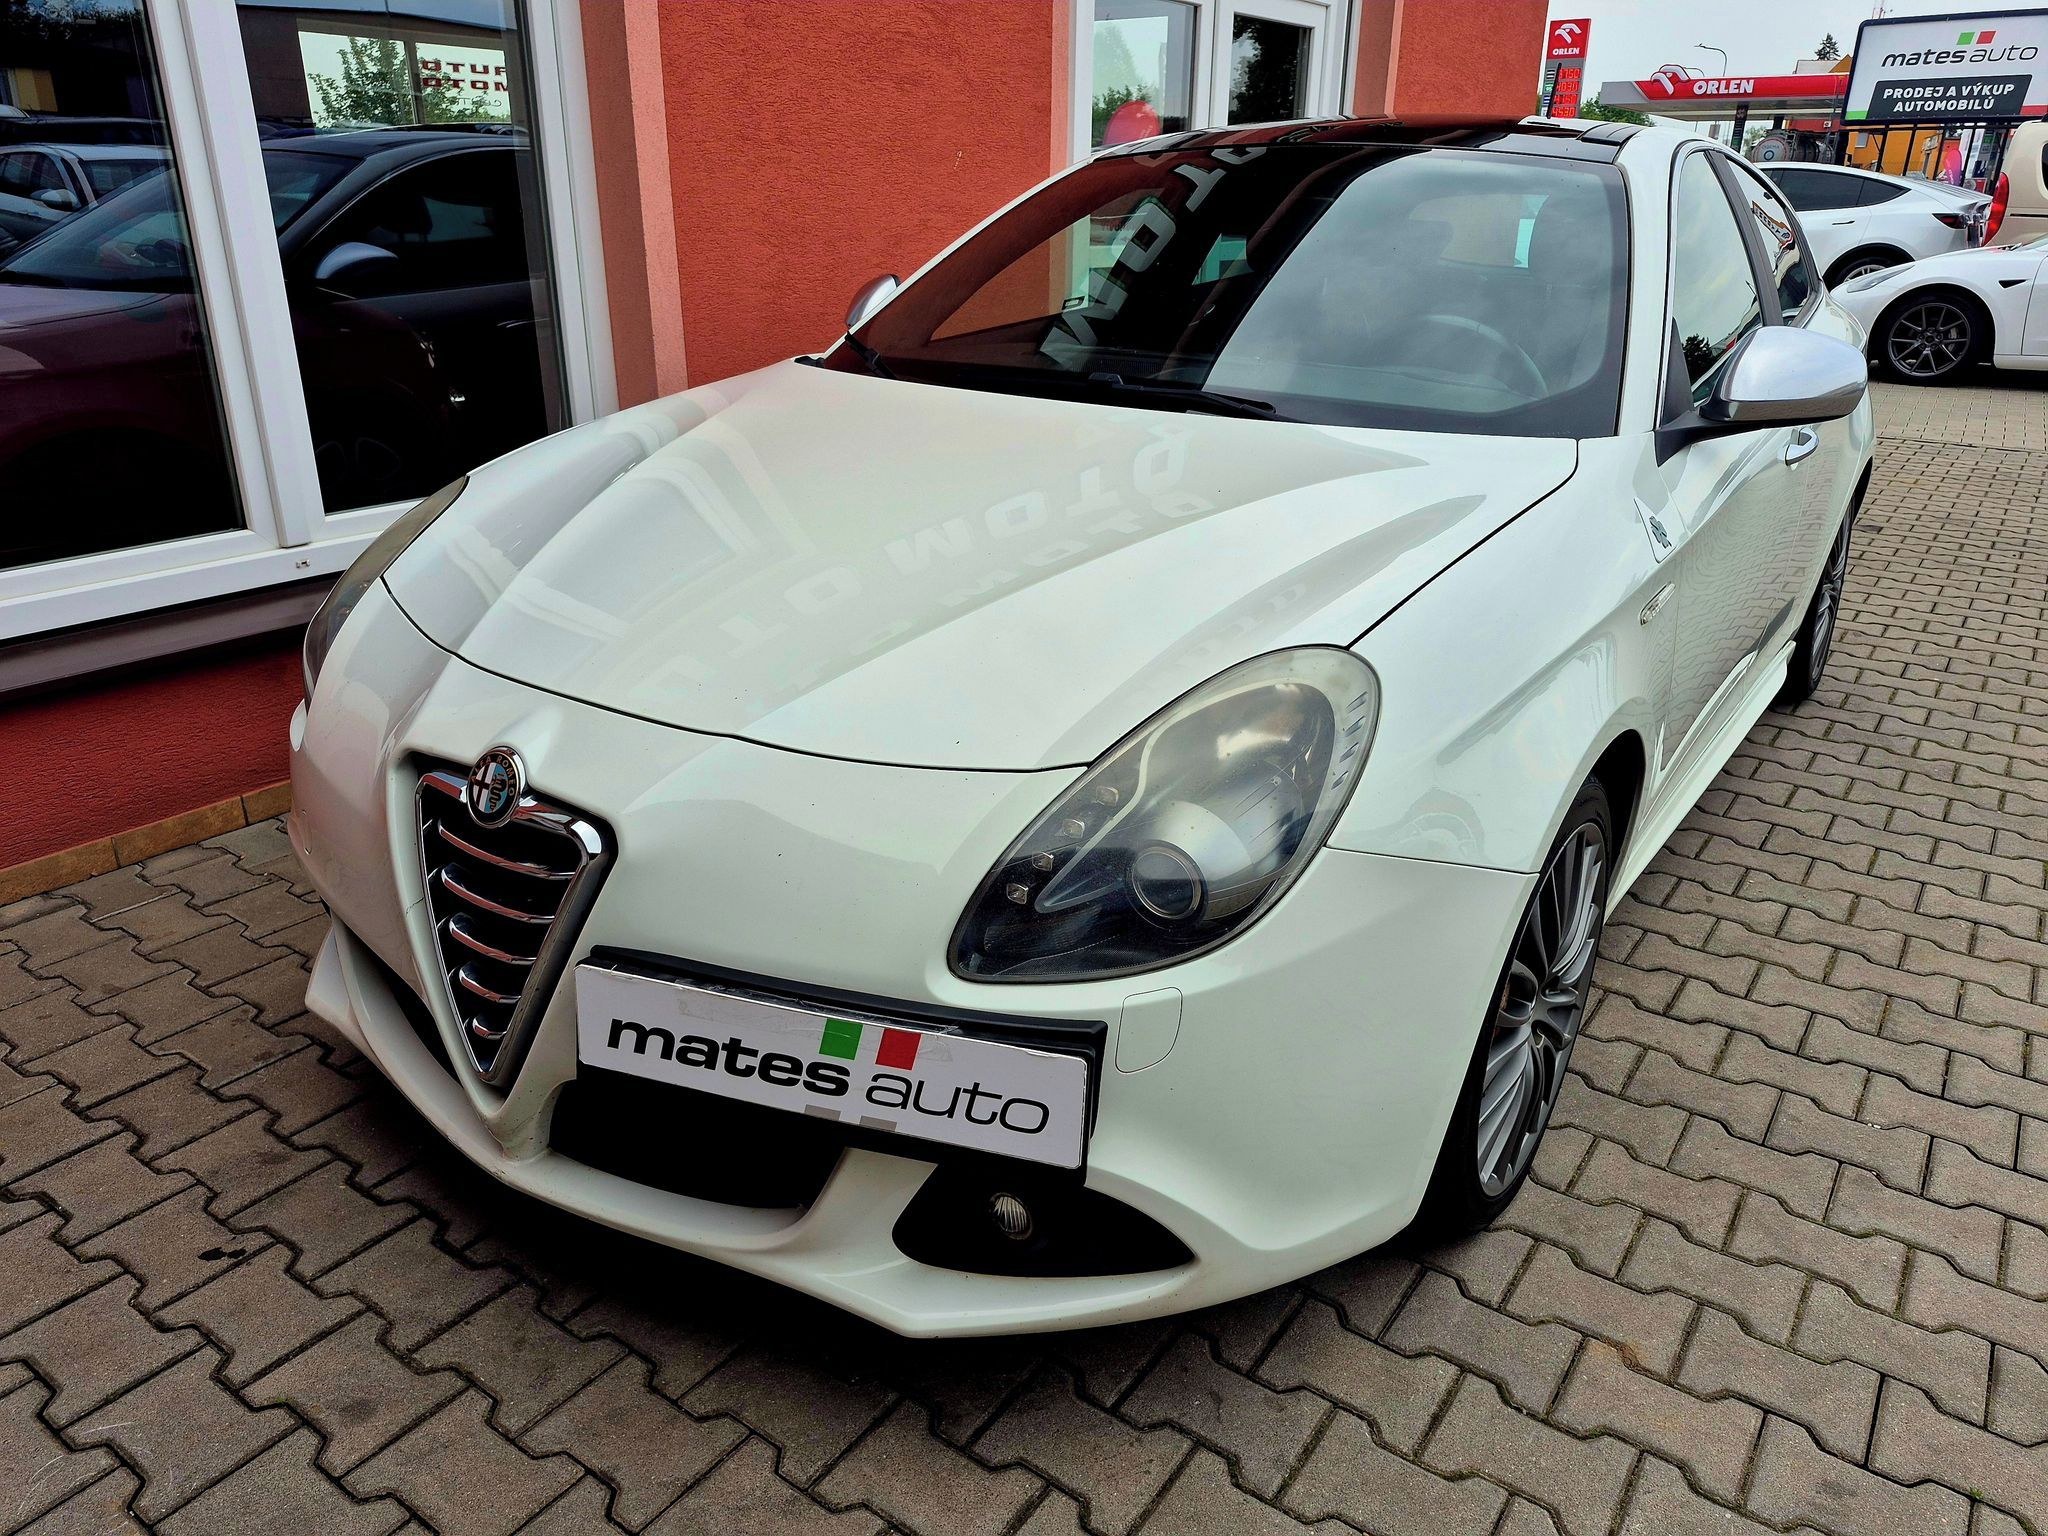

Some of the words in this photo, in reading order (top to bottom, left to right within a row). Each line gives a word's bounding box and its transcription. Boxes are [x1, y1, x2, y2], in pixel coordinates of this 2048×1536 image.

[1552, 47, 1580, 56] ORLEN
[1881, 48, 1967, 67] mates
[1969, 44, 2039, 63] auto
[1693, 79, 1755, 95] ORLEN
[1883, 86, 1944, 99] PRODEJ
[1945, 86, 1957, 97] A
[1961, 82, 2015, 97] VÝKUP
[607, 1017, 850, 1097] mates
[865, 1072, 1050, 1134] auto
